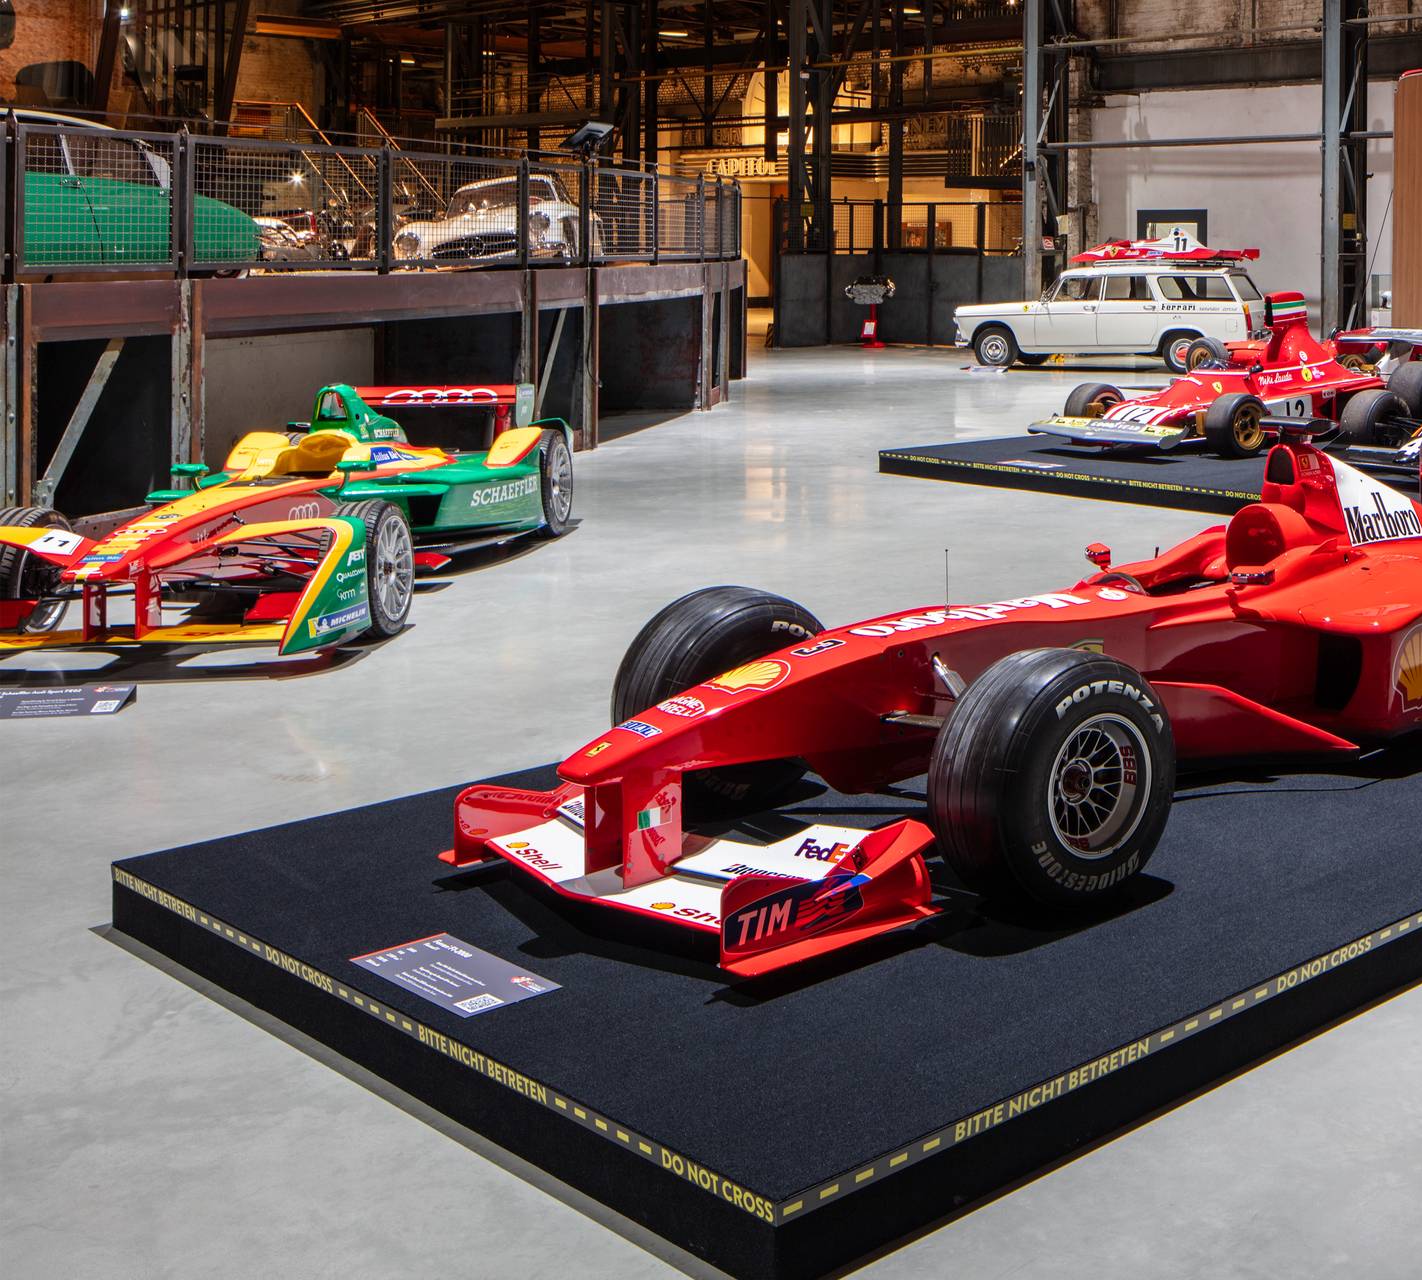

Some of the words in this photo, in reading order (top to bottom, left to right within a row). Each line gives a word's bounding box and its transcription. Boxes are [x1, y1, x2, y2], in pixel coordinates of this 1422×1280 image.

[1174, 237, 1188, 251] 11
[1258, 375, 1274, 386] Niki
[1121, 407, 1156, 422] 12
[470, 476, 538, 507] SCHAEFFLER
[1129, 480, 1142, 488] BITTE
[1143, 482, 1157, 490] NICHT
[1158, 483, 1183, 491] BETRETEN
[1234, 491, 1246, 499] NOT
[1247, 492, 1261, 500] CROS
[1344, 492, 1421, 545] Marlboro
[43, 536, 70, 548] 11
[330, 607, 367, 627] MICHELIN
[849, 592, 1091, 637] Marlboro
[1055, 679, 1164, 734] POTENZA
[1120, 745, 1137, 786] BBS
[515, 849, 563, 871] Shell
[795, 838, 850, 864] FedE
[1032, 841, 1140, 892] BRIDGESTONE
[114, 867, 135, 891] BITTE
[135, 879, 159, 901] NICHT
[159, 890, 196, 921] BETRETEN
[673, 907, 721, 926] She
[737, 898, 793, 946] TIM
[265, 945, 280, 964] DO
[281, 954, 301, 975] NOT
[302, 964, 333, 993] CROSS
[1277, 972, 1297, 993] DO
[1300, 956, 1329, 982] NOT
[1331, 936, 1372, 967] CROSS
[418, 1024, 447, 1054] BITTE
[449, 1039, 487, 1073] NICHT
[487, 1059, 547, 1105] BETRETEN
[954, 1103, 1004, 1143] BITTE
[1008, 1075, 1064, 1118] NICHT
[1067, 1038, 1151, 1091] BETRETEN
[660, 1148, 684, 1177] DO
[686, 1161, 720, 1196] NOT
[721, 1179, 774, 1224] CROSS
